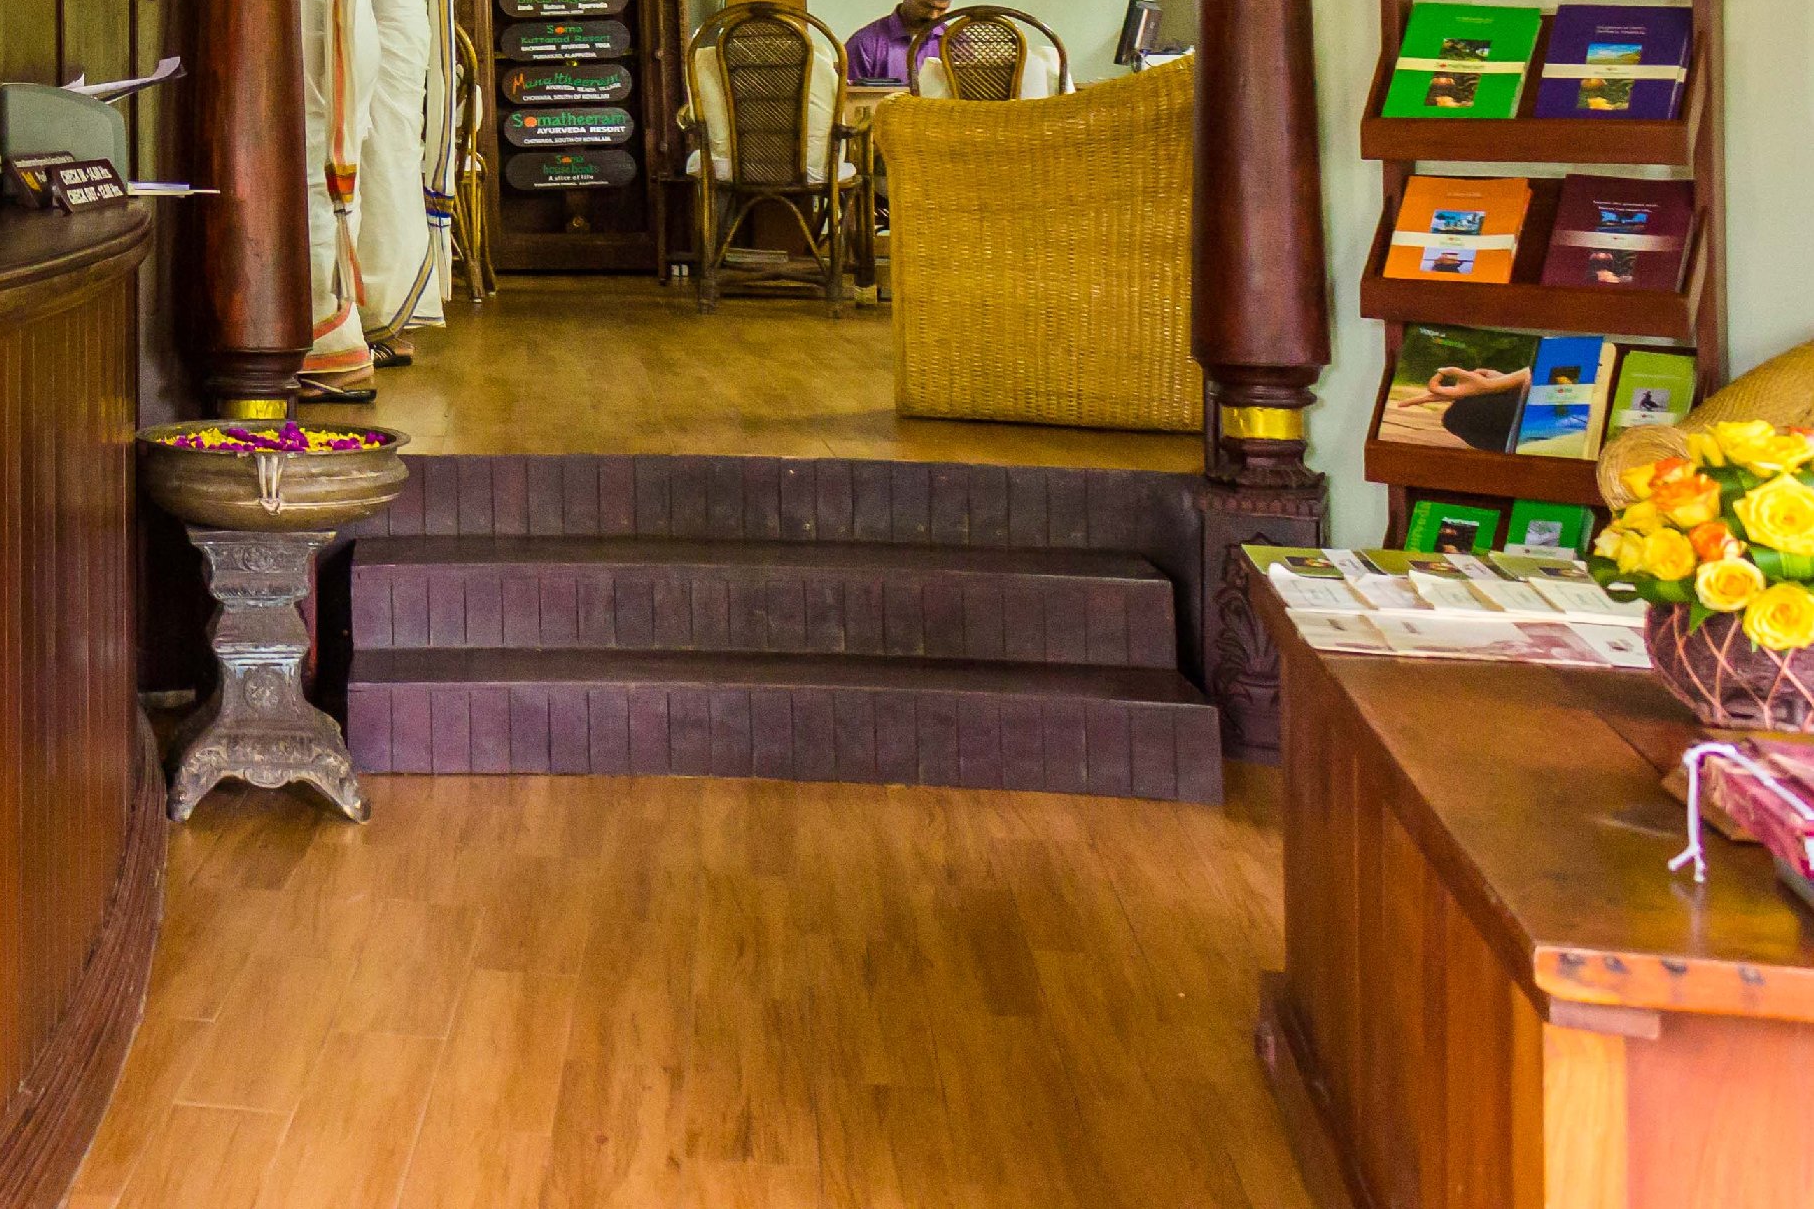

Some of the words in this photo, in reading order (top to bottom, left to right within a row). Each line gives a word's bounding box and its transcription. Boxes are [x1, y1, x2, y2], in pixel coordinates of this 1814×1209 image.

[547, 25, 583, 34] Soma
[512, 111, 626, 128] Somatheeram
[60, 169, 83, 185] CHECK
[67, 188, 90, 205] CHECK
